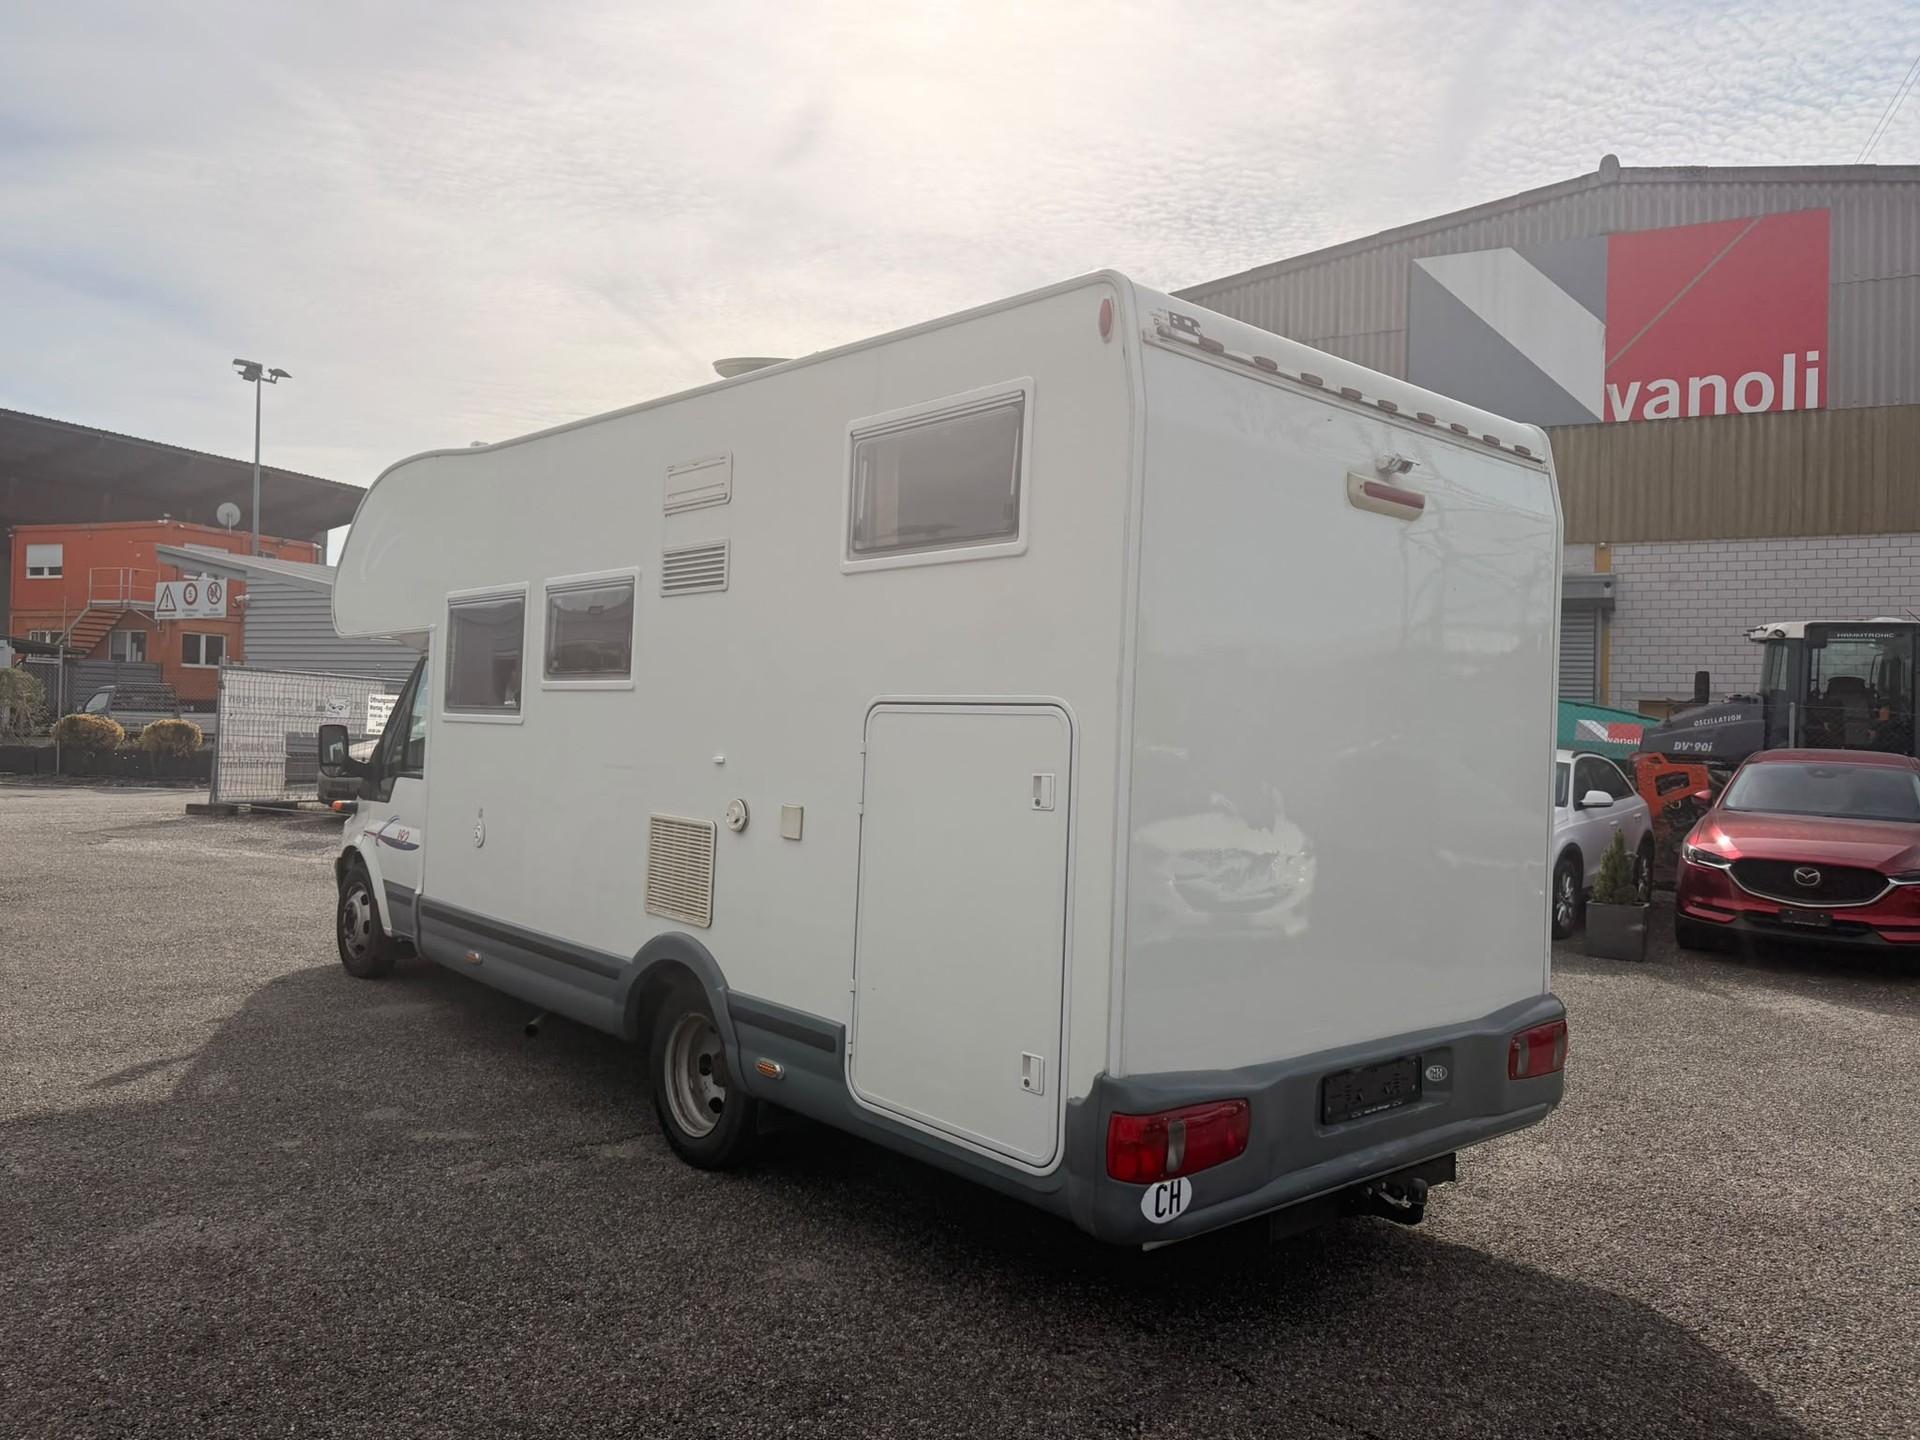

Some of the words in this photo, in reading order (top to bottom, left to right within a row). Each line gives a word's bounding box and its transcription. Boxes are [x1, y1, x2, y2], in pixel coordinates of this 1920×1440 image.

[1606, 351, 1820, 421] vanoli
[1693, 714, 1742, 727] OSCILLATION
[1607, 737, 1641, 745] vanoli
[1155, 1180, 1181, 1218] CH
